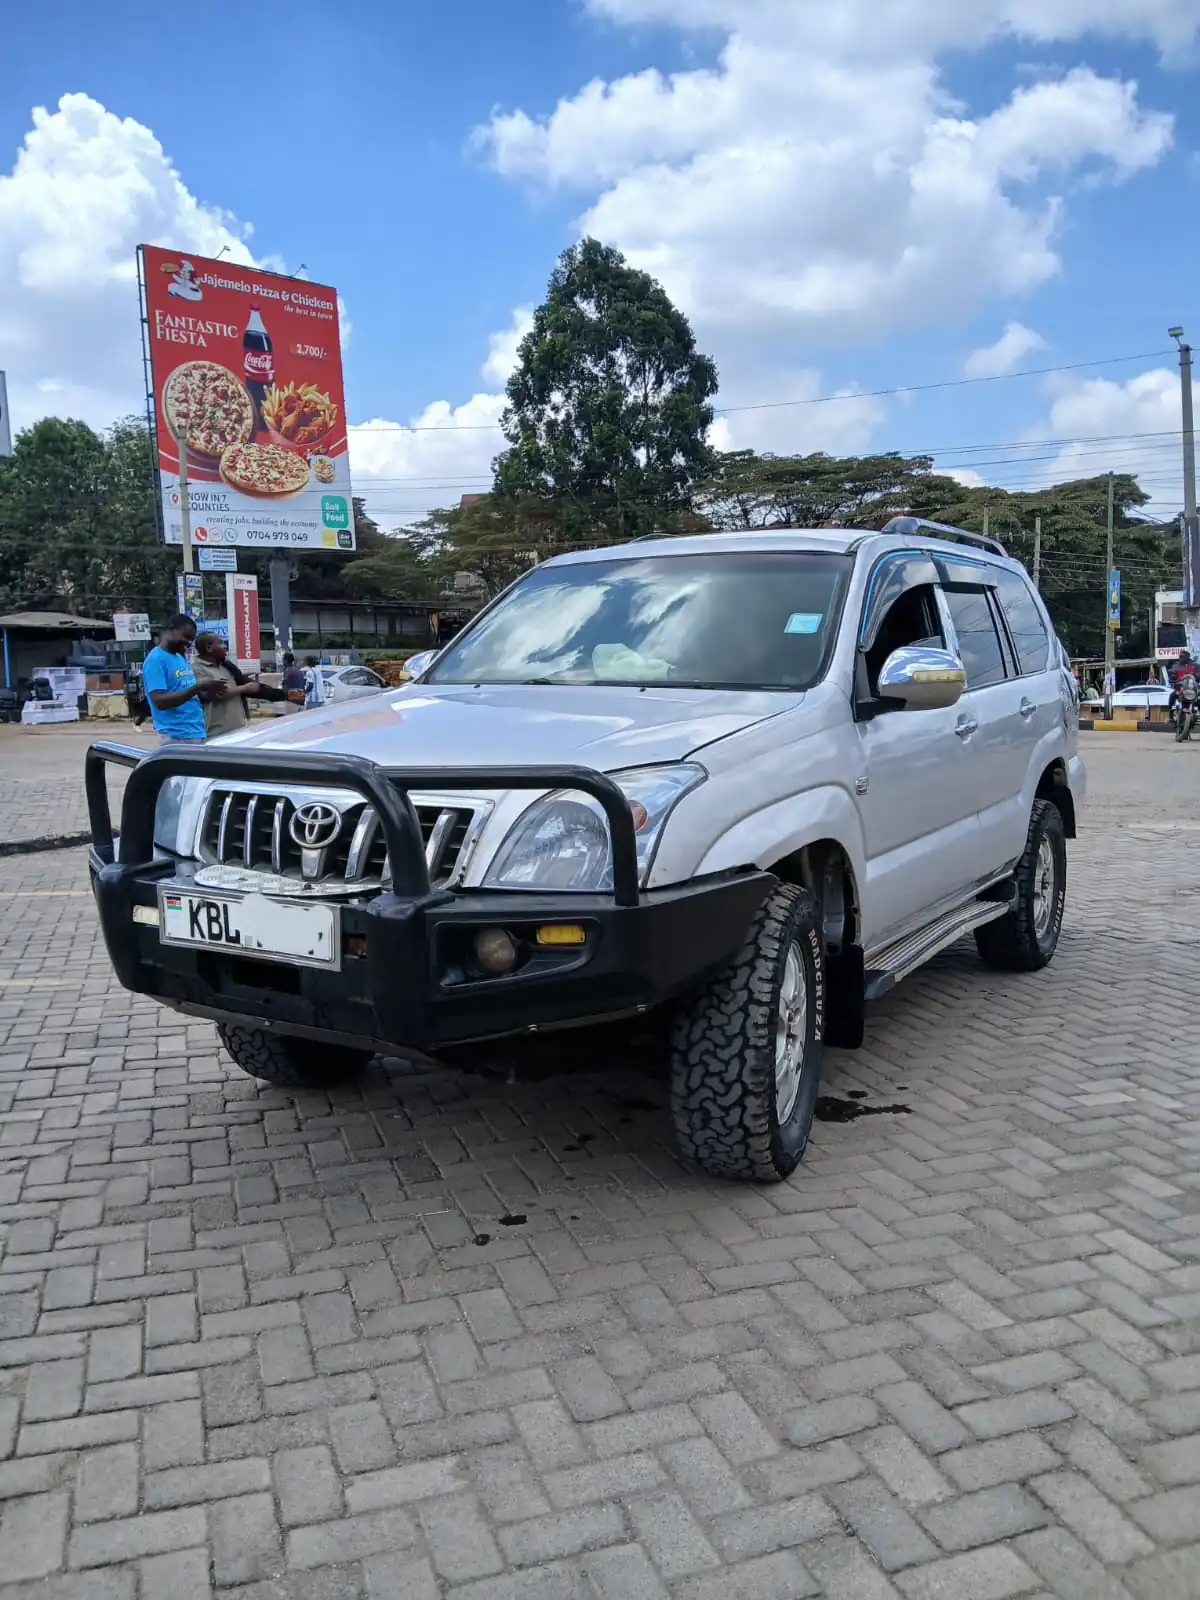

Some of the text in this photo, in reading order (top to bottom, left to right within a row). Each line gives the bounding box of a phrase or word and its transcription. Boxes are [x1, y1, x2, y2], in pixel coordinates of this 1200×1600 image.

[200, 273, 334, 311] Jajemelo Pizza & Chicken
[284, 304, 333, 321] the best in town
[154, 309, 239, 339] FANTASTIC
[155, 324, 207, 348] FIESTA
[296, 343, 328, 359] 2,700/-
[188, 492, 228, 503] NOW IN 7
[206, 516, 234, 526] creating
[252, 516, 279, 527] building
[280, 517, 289, 527] the
[291, 519, 318, 530] economy
[326, 511, 345, 522] Food
[246, 530, 308, 542] 0704 979 049
[242, 590, 252, 659] QUICKMART
[188, 898, 241, 945] KBL
[807, 928, 823, 1041] ROADCRUZA
